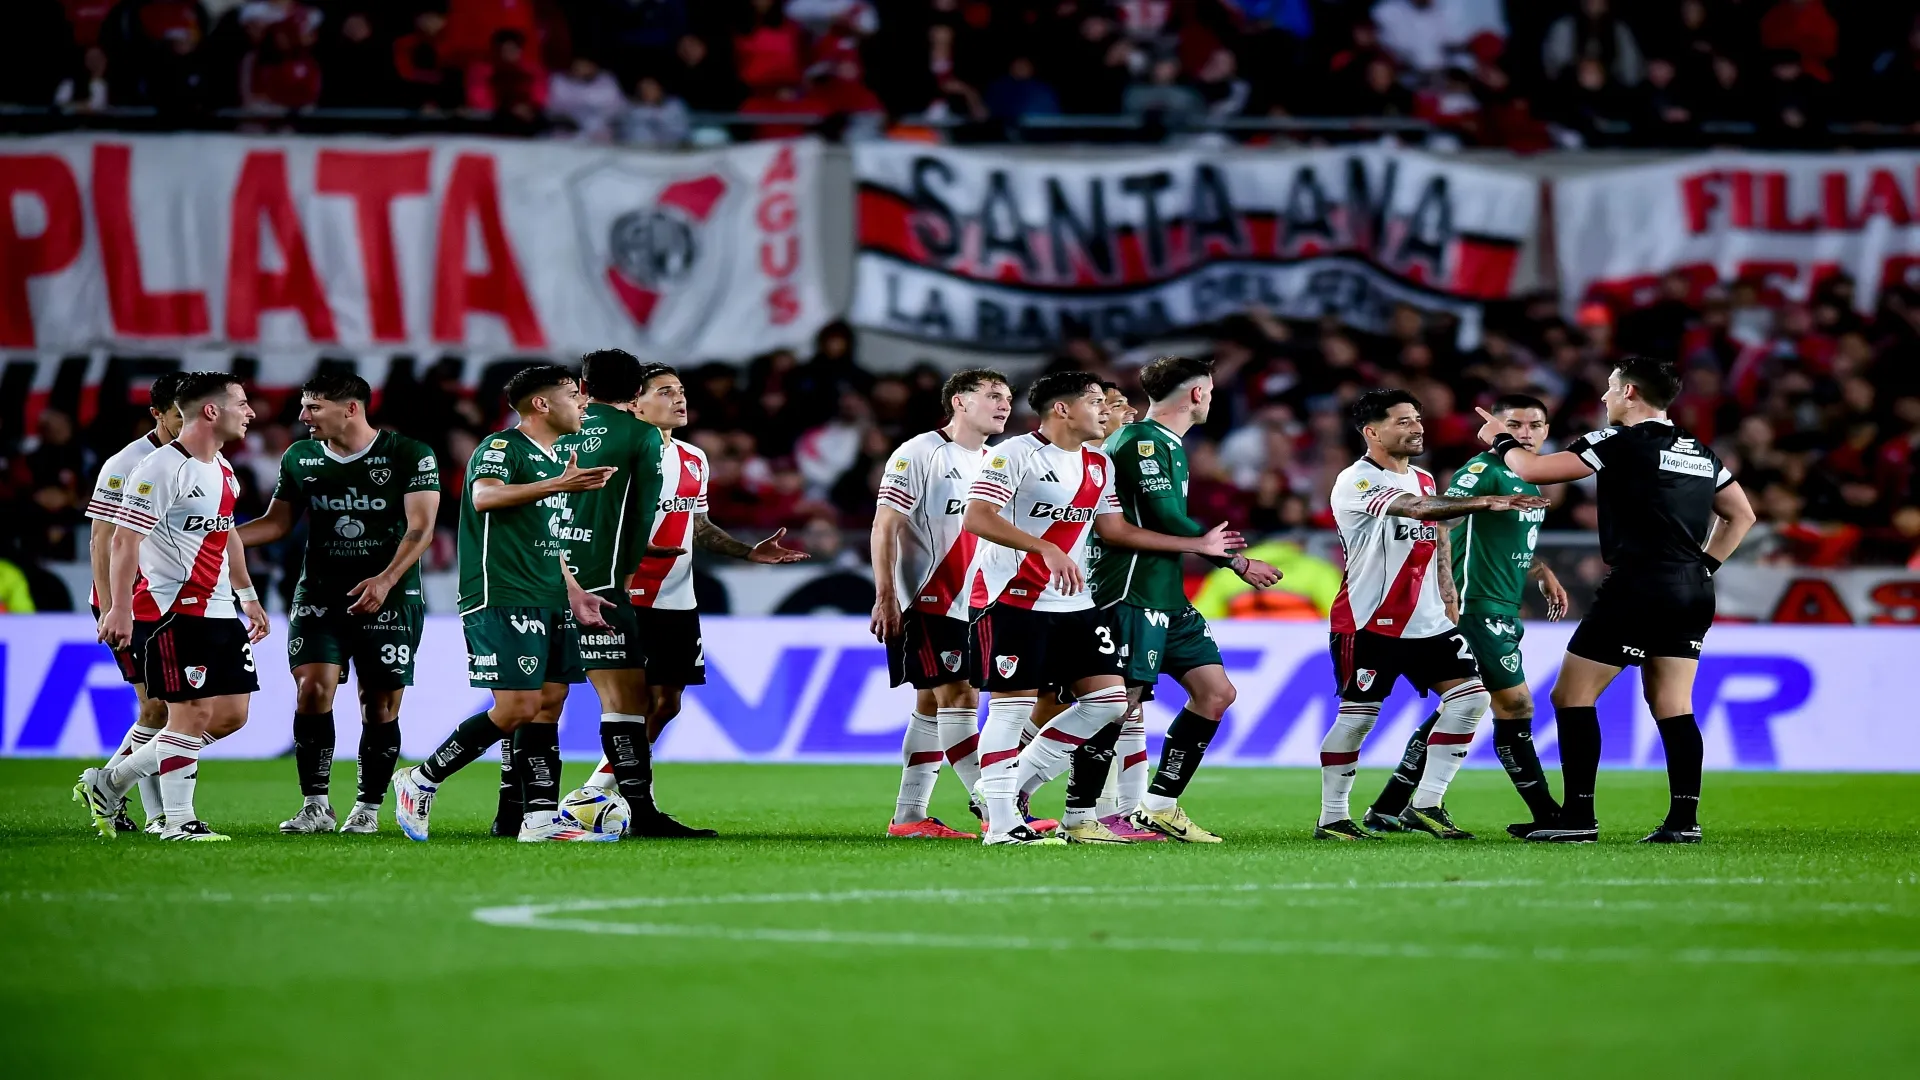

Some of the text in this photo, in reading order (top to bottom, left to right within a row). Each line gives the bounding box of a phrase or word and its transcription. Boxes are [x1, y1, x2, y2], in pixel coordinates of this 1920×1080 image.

[908, 156, 1243, 280] SANTA
[1678, 168, 1920, 236] FILIA
[0, 143, 546, 348] PLATA
[757, 143, 800, 326] AGUS
[885, 272, 948, 333] LA
[310, 487, 387, 511] Naldo
[1139, 477, 1170, 487] SIGMA
[1142, 483, 1172, 494] AGRO
[380, 643, 411, 665] 39
[1622, 645, 1646, 658] TCL
